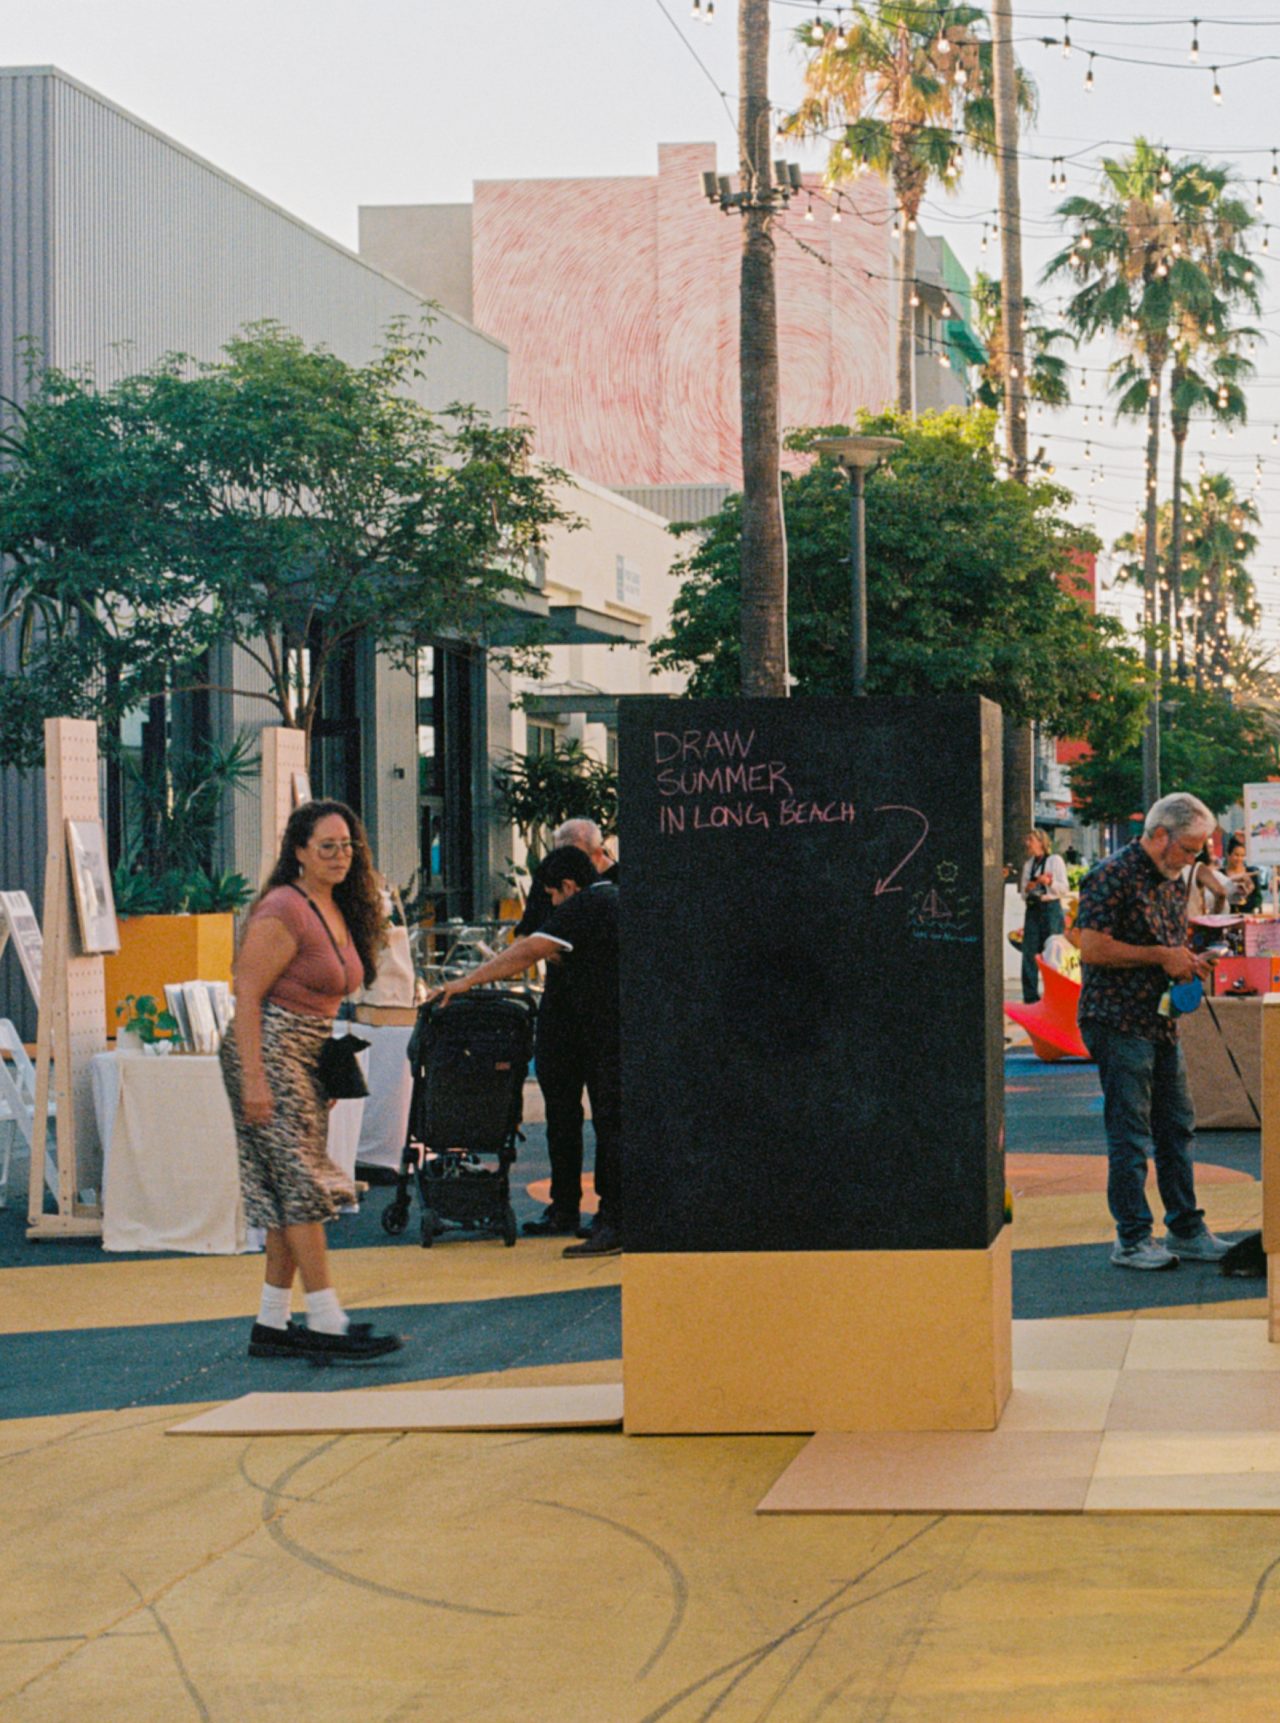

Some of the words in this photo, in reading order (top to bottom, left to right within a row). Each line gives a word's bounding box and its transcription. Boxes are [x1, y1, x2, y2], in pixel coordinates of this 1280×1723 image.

[654, 729, 755, 764] DRAW
[657, 761, 794, 796] SUMMER
[660, 804, 685, 834] IN
[694, 801, 770, 830] LONG
[779, 799, 856, 825] BEACH
